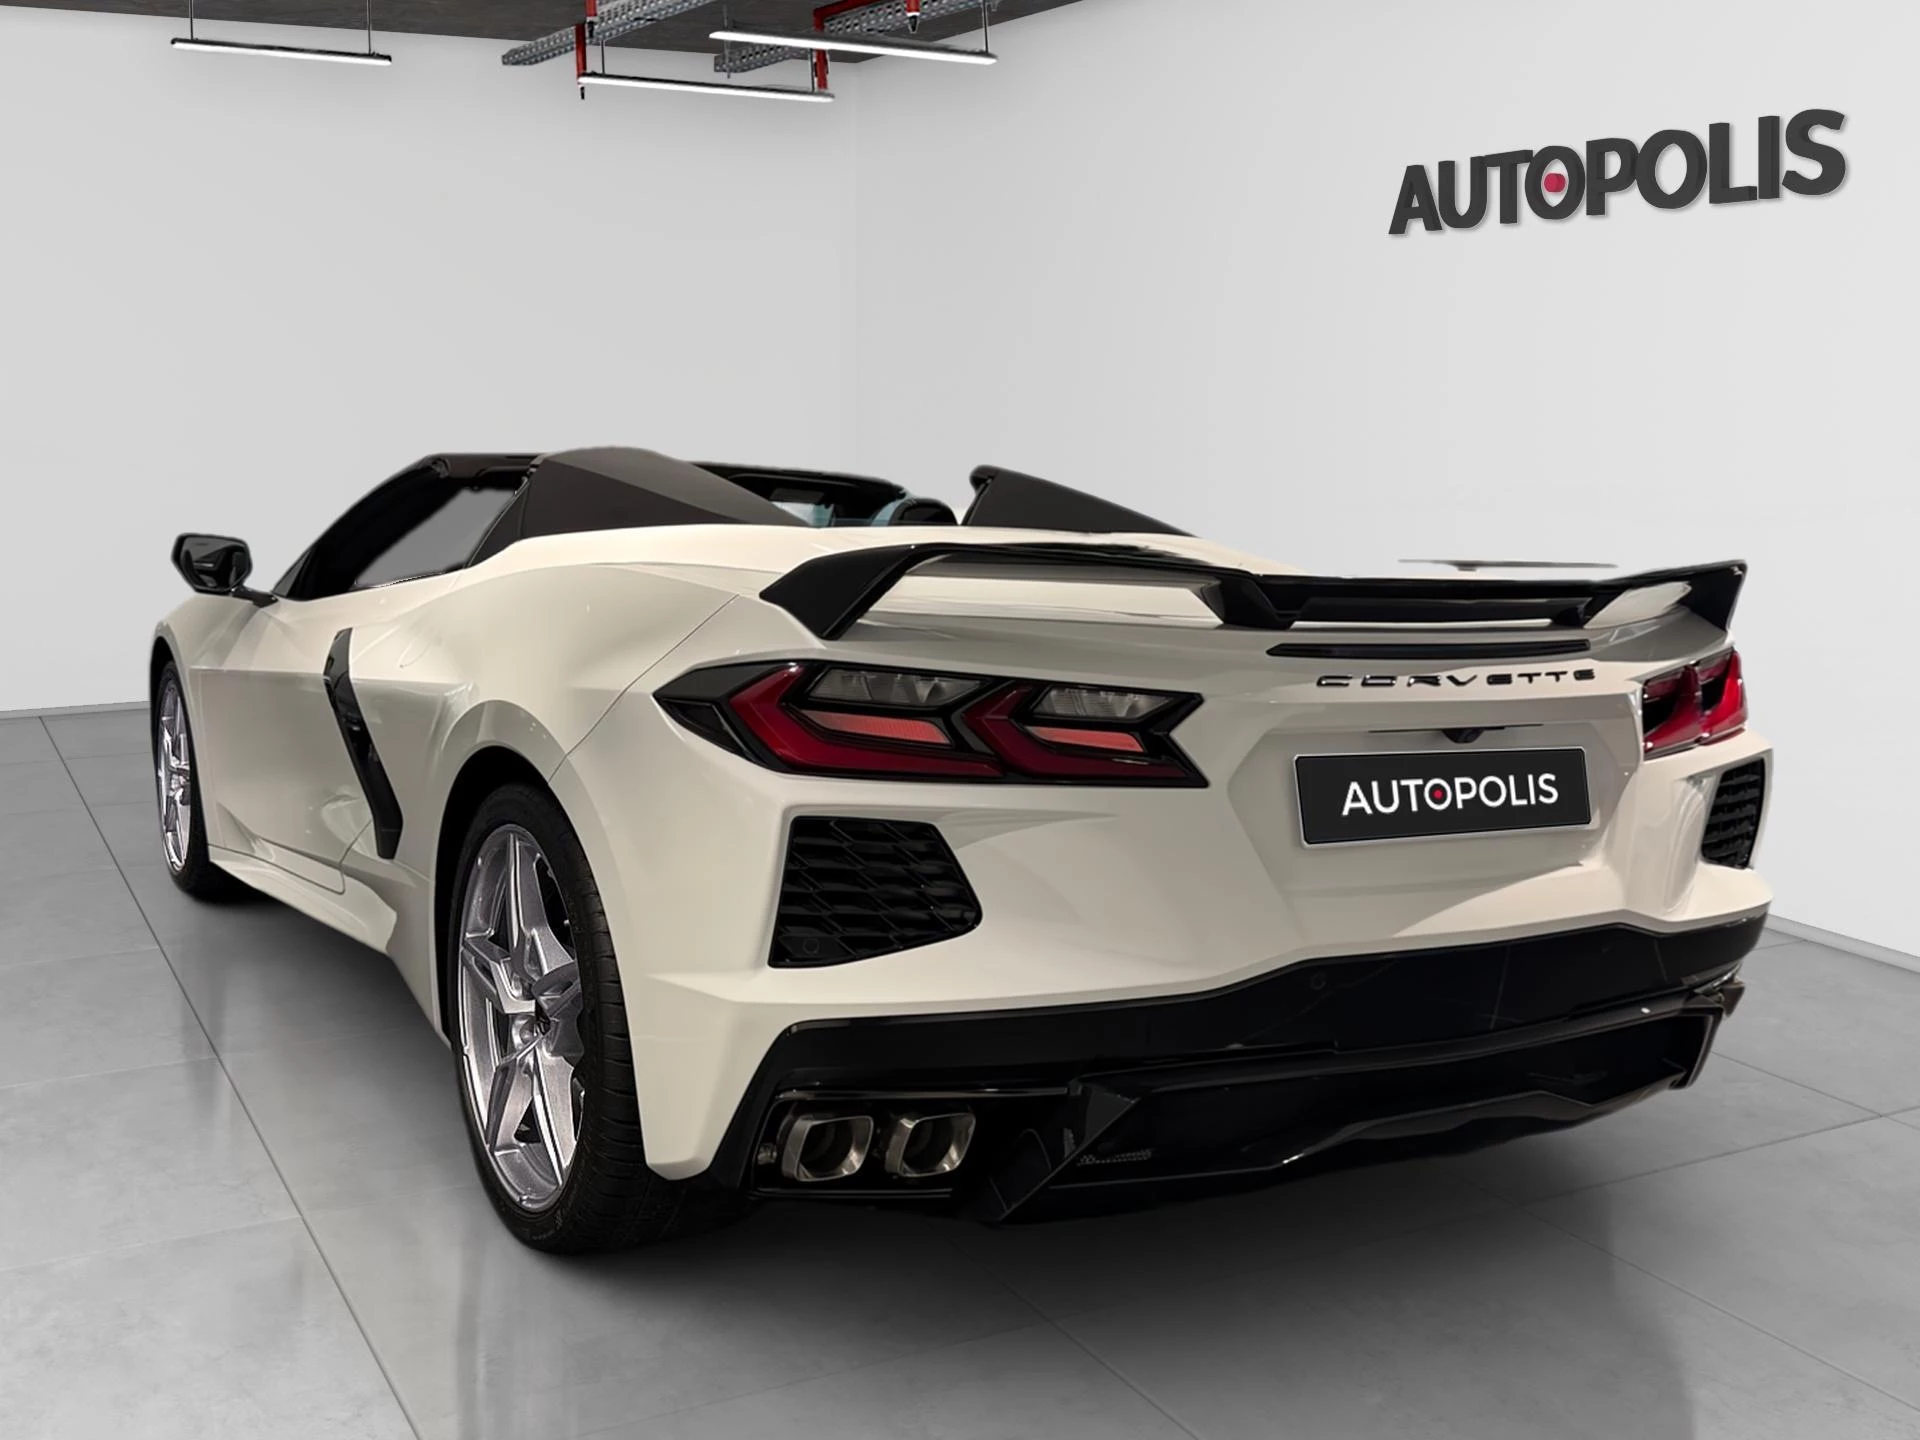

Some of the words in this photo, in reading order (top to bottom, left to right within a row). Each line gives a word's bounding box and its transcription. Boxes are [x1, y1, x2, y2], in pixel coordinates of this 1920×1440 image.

[1389, 108, 1846, 235] AUTOPOLIS
[1316, 668, 1596, 687] CORVETTE
[1342, 773, 1559, 816] AUTOPOLIS
